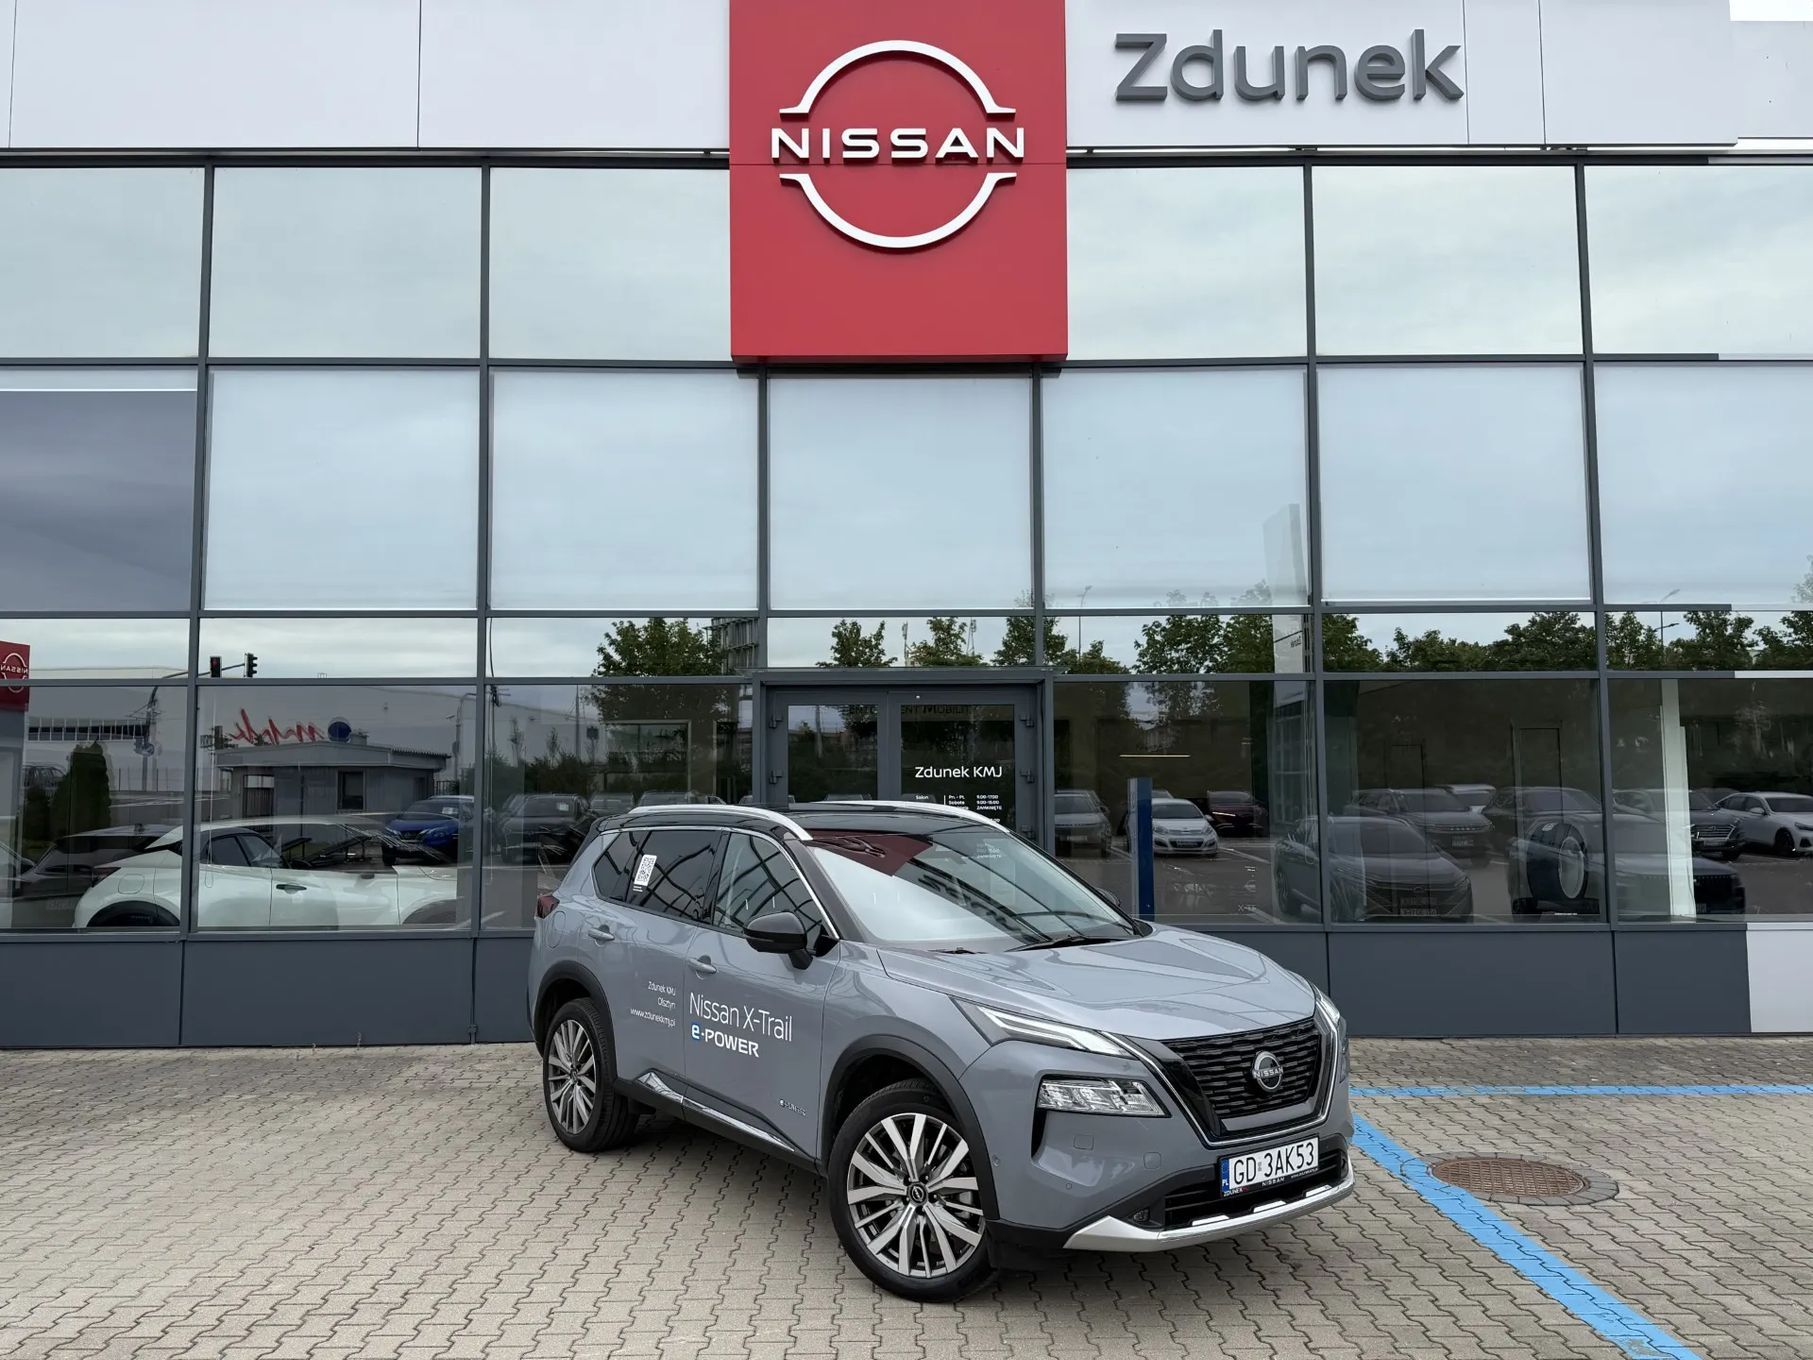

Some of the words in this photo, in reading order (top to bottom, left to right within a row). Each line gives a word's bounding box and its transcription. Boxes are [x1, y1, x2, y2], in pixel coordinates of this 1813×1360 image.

[1115, 29, 1464, 101] Zdunek
[771, 127, 1026, 162] NISSAN
[915, 766, 970, 778] Zdunek
[973, 766, 1003, 778] KMJ
[657, 997, 676, 1010] Olsztyn
[689, 992, 740, 1027] Nissan
[742, 1005, 793, 1042] X-Trail
[691, 1023, 760, 1058] e-POWER
[1252, 1066, 1284, 1079] NISSAN
[1233, 1156, 1257, 1185] GD
[1263, 1142, 1314, 1178] 3AK53
[1261, 1177, 1285, 1187] NISSAN
